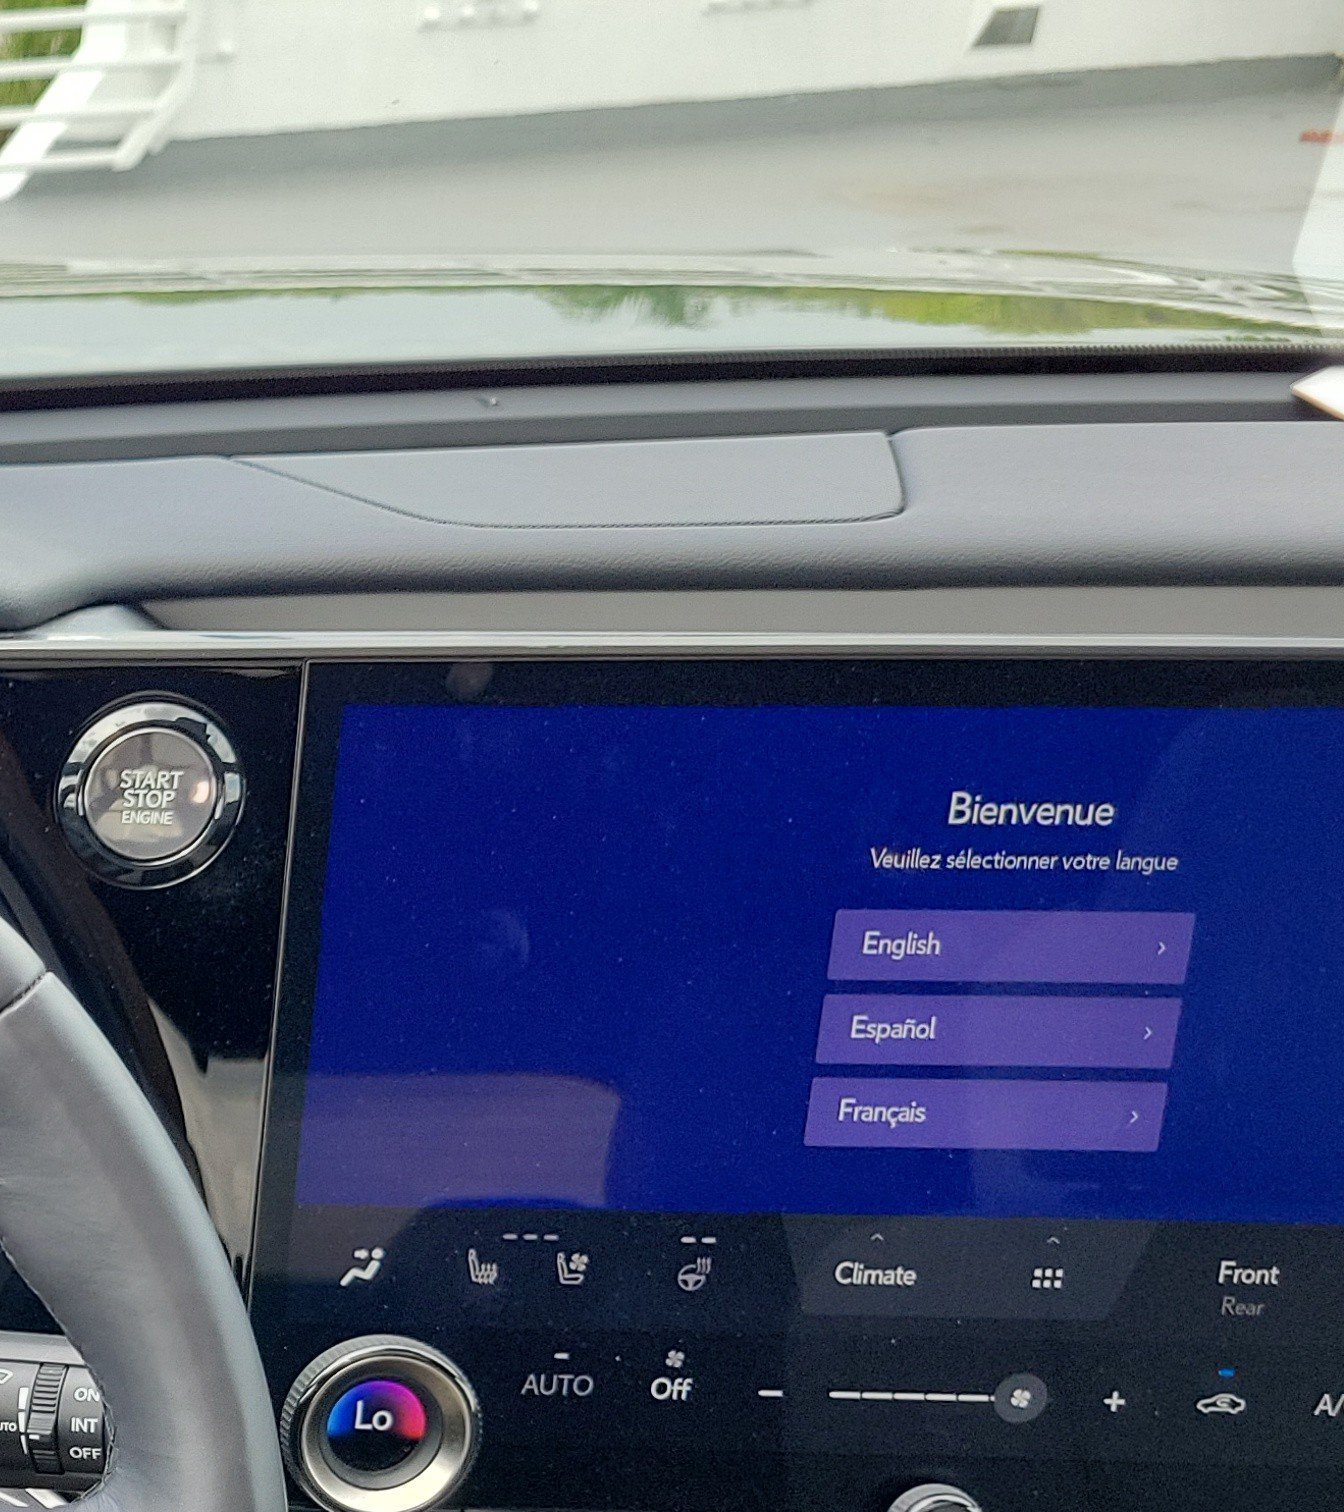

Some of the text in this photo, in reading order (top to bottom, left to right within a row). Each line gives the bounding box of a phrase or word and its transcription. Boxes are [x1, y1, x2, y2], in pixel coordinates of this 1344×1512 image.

[119, 769, 184, 790] START
[123, 789, 176, 809] STOP
[947, 790, 1116, 827] Bienvenue
[121, 810, 174, 826] ENGINE
[869, 847, 1179, 876] Veuillez sélectionner votre langue
[862, 931, 941, 961] English
[849, 1015, 937, 1044] Español
[837, 1097, 926, 1128] Français
[834, 1260, 917, 1287] Climate
[1218, 1260, 1280, 1287] Front
[1221, 1297, 1265, 1317] Rear
[74, 1388, 100, 1402] ON
[521, 1374, 594, 1398] AUTO
[650, 1377, 693, 1402] Off
[71, 1417, 98, 1433] INT
[354, 1400, 394, 1432] Lo
[69, 1447, 102, 1460] OFF
